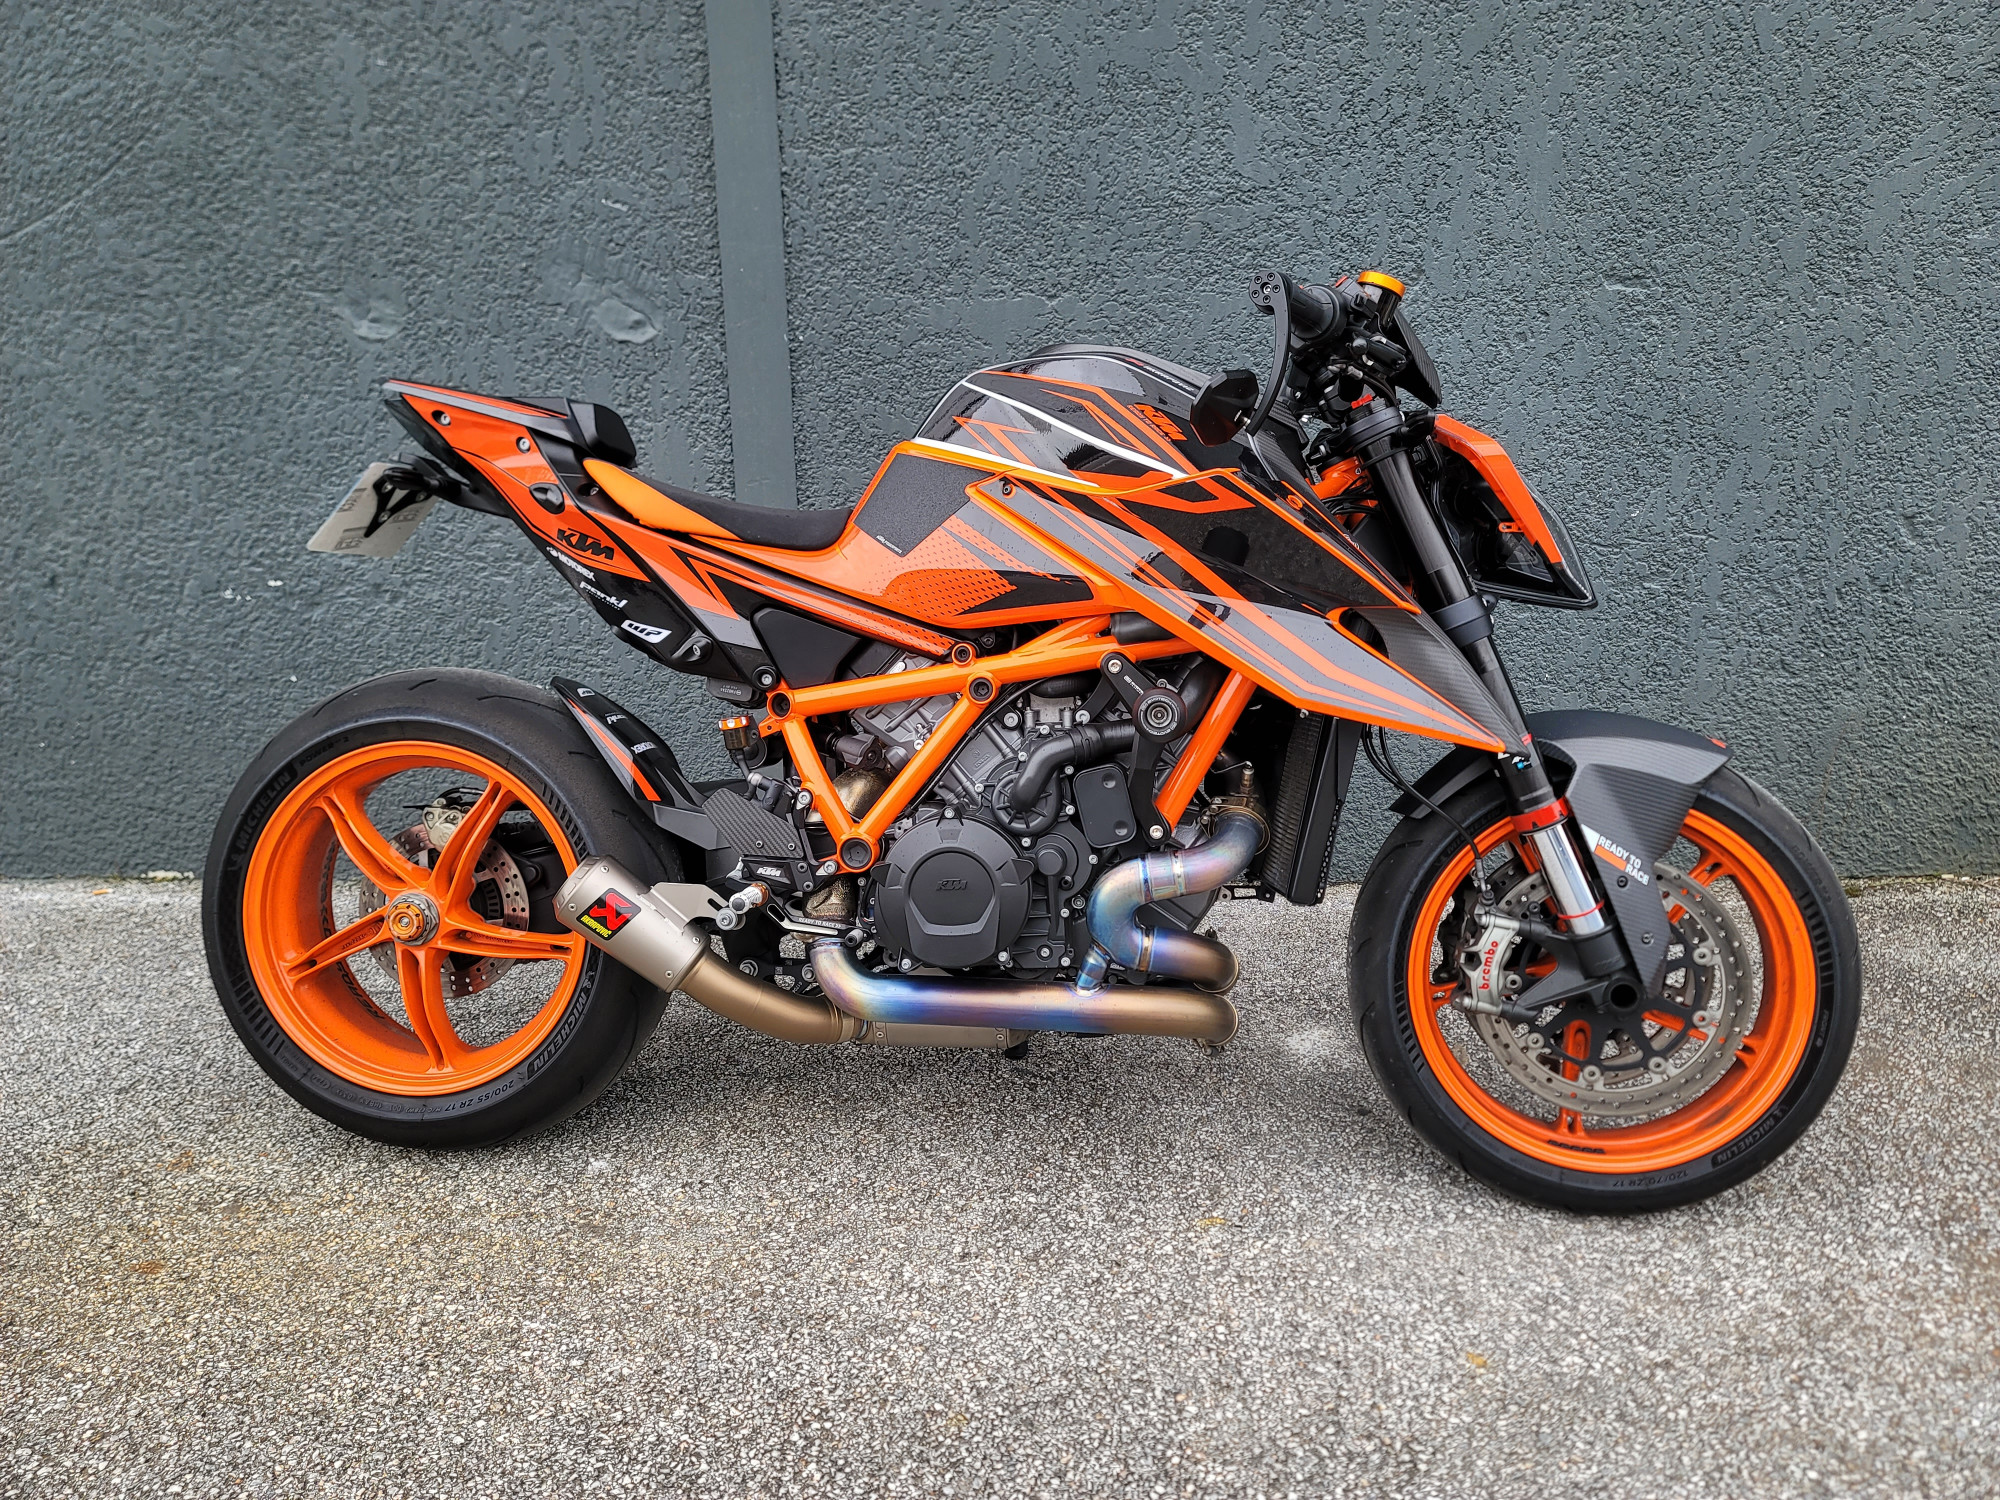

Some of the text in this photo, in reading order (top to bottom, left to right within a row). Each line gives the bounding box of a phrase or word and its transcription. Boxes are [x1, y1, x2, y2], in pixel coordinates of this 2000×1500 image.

[1133, 403, 1188, 440] KTM
[557, 528, 614, 560] KTM
[558, 550, 596, 581] MOTOREX
[580, 581, 628, 608] pankl
[627, 622, 662, 637] WP
[237, 769, 294, 851] MICHELIN
[1598, 835, 1642, 869] READY TO
[756, 866, 782, 877] KTM
[936, 878, 968, 891] KTM
[1624, 863, 1650, 886] RACE
[1478, 940, 1499, 991] brembo
[533, 991, 588, 1072] MICHELIN
[459, 1098, 473, 1109] ZR
[477, 1079, 515, 1104] 200/55
[444, 1103, 458, 1112] 17
[1717, 1116, 1776, 1163] MICHELIN
[1628, 1179, 1643, 1187] ZR
[1649, 1169, 1690, 1186] 120/70
